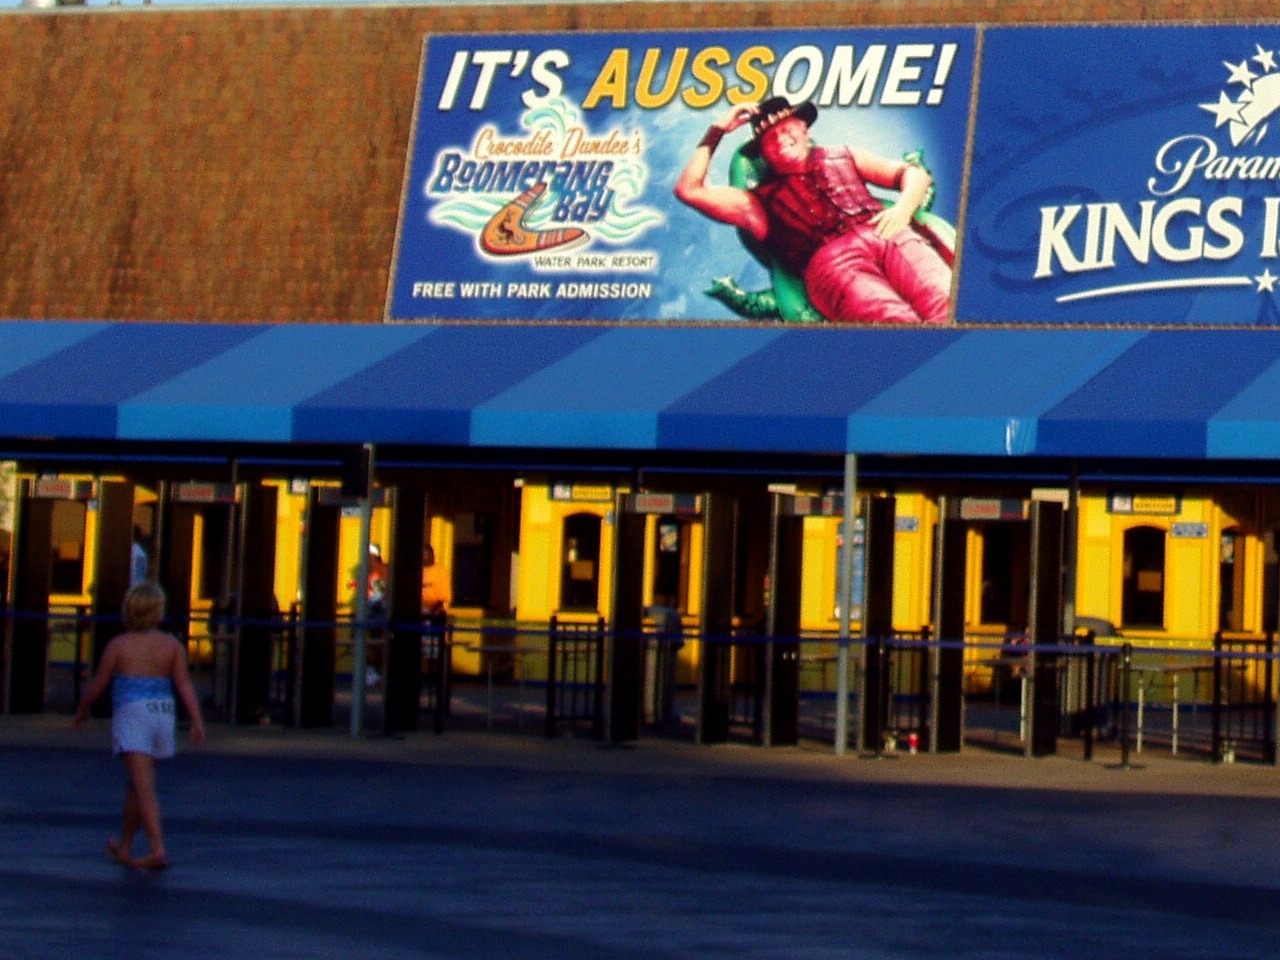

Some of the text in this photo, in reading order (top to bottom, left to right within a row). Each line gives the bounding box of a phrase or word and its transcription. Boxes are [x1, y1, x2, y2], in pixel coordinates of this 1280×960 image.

[439, 43, 958, 111] IT'S AUSSOME!
[474, 127, 642, 158] Crocodile Dundee's
[1033, 198, 1246, 279] KINGS
[534, 255, 654, 268] WATER PARK RESORT
[412, 283, 652, 299] FREE WITH PARK ADMISSION
